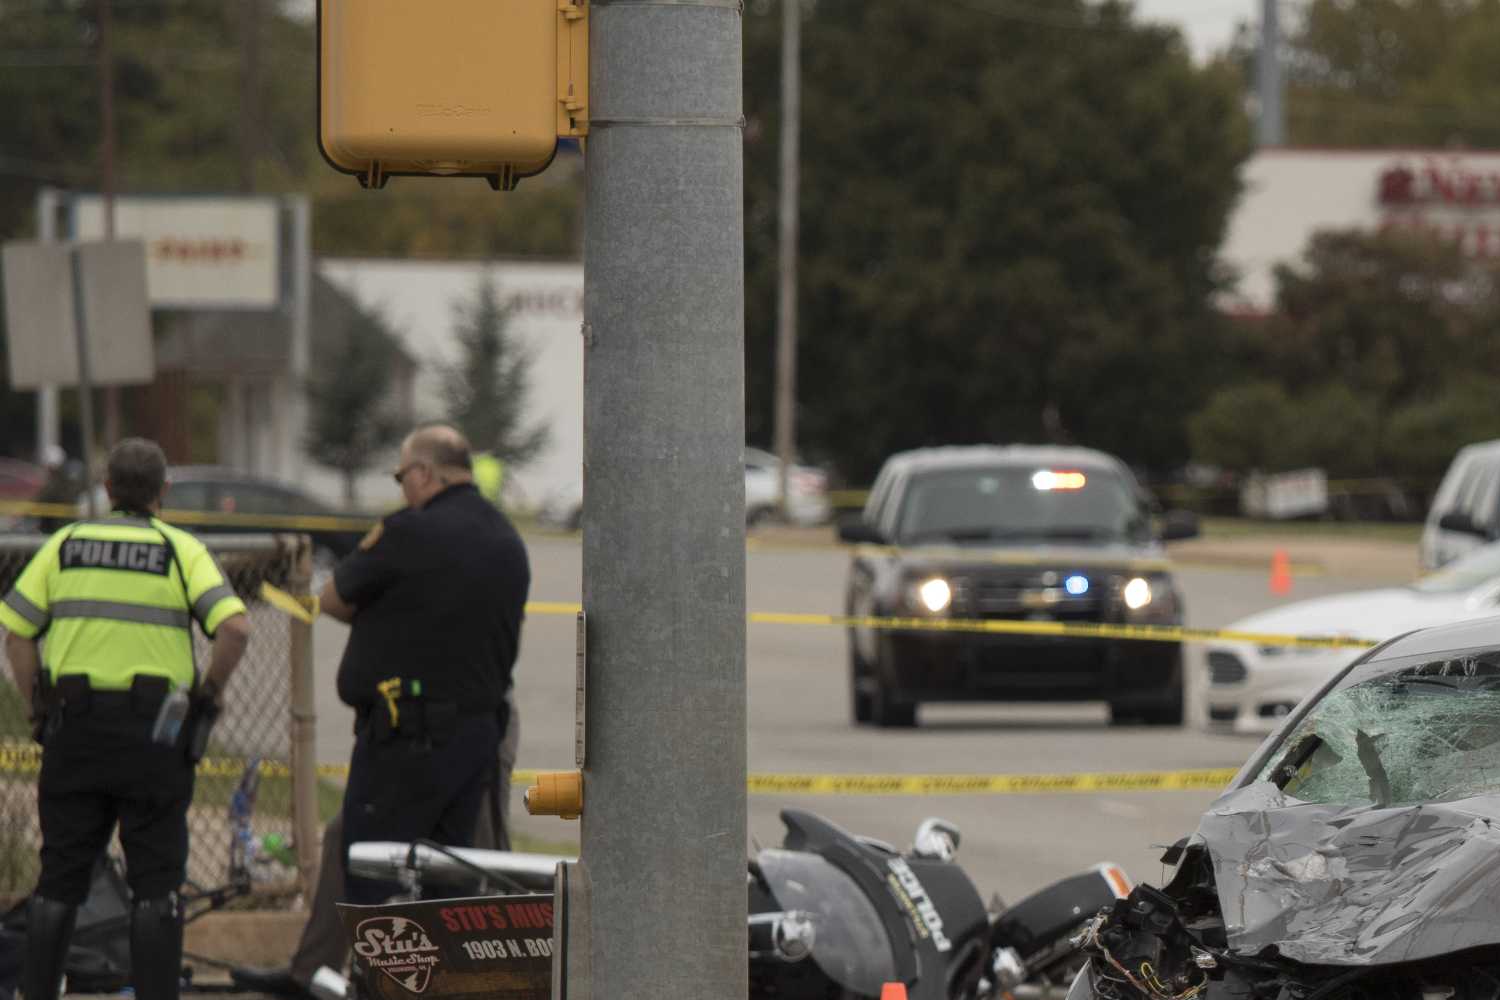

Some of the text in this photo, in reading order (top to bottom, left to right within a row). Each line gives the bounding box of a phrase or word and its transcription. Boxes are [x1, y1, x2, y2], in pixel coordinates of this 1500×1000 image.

[63, 540, 166, 573] POLICE
[439, 905, 508, 932] STU'S
[887, 857, 952, 953] POLICE
[354, 928, 440, 957] Stu's
[461, 939, 507, 960] 1903
[505, 938, 527, 959] N.
[367, 953, 440, 967] Music Shop
